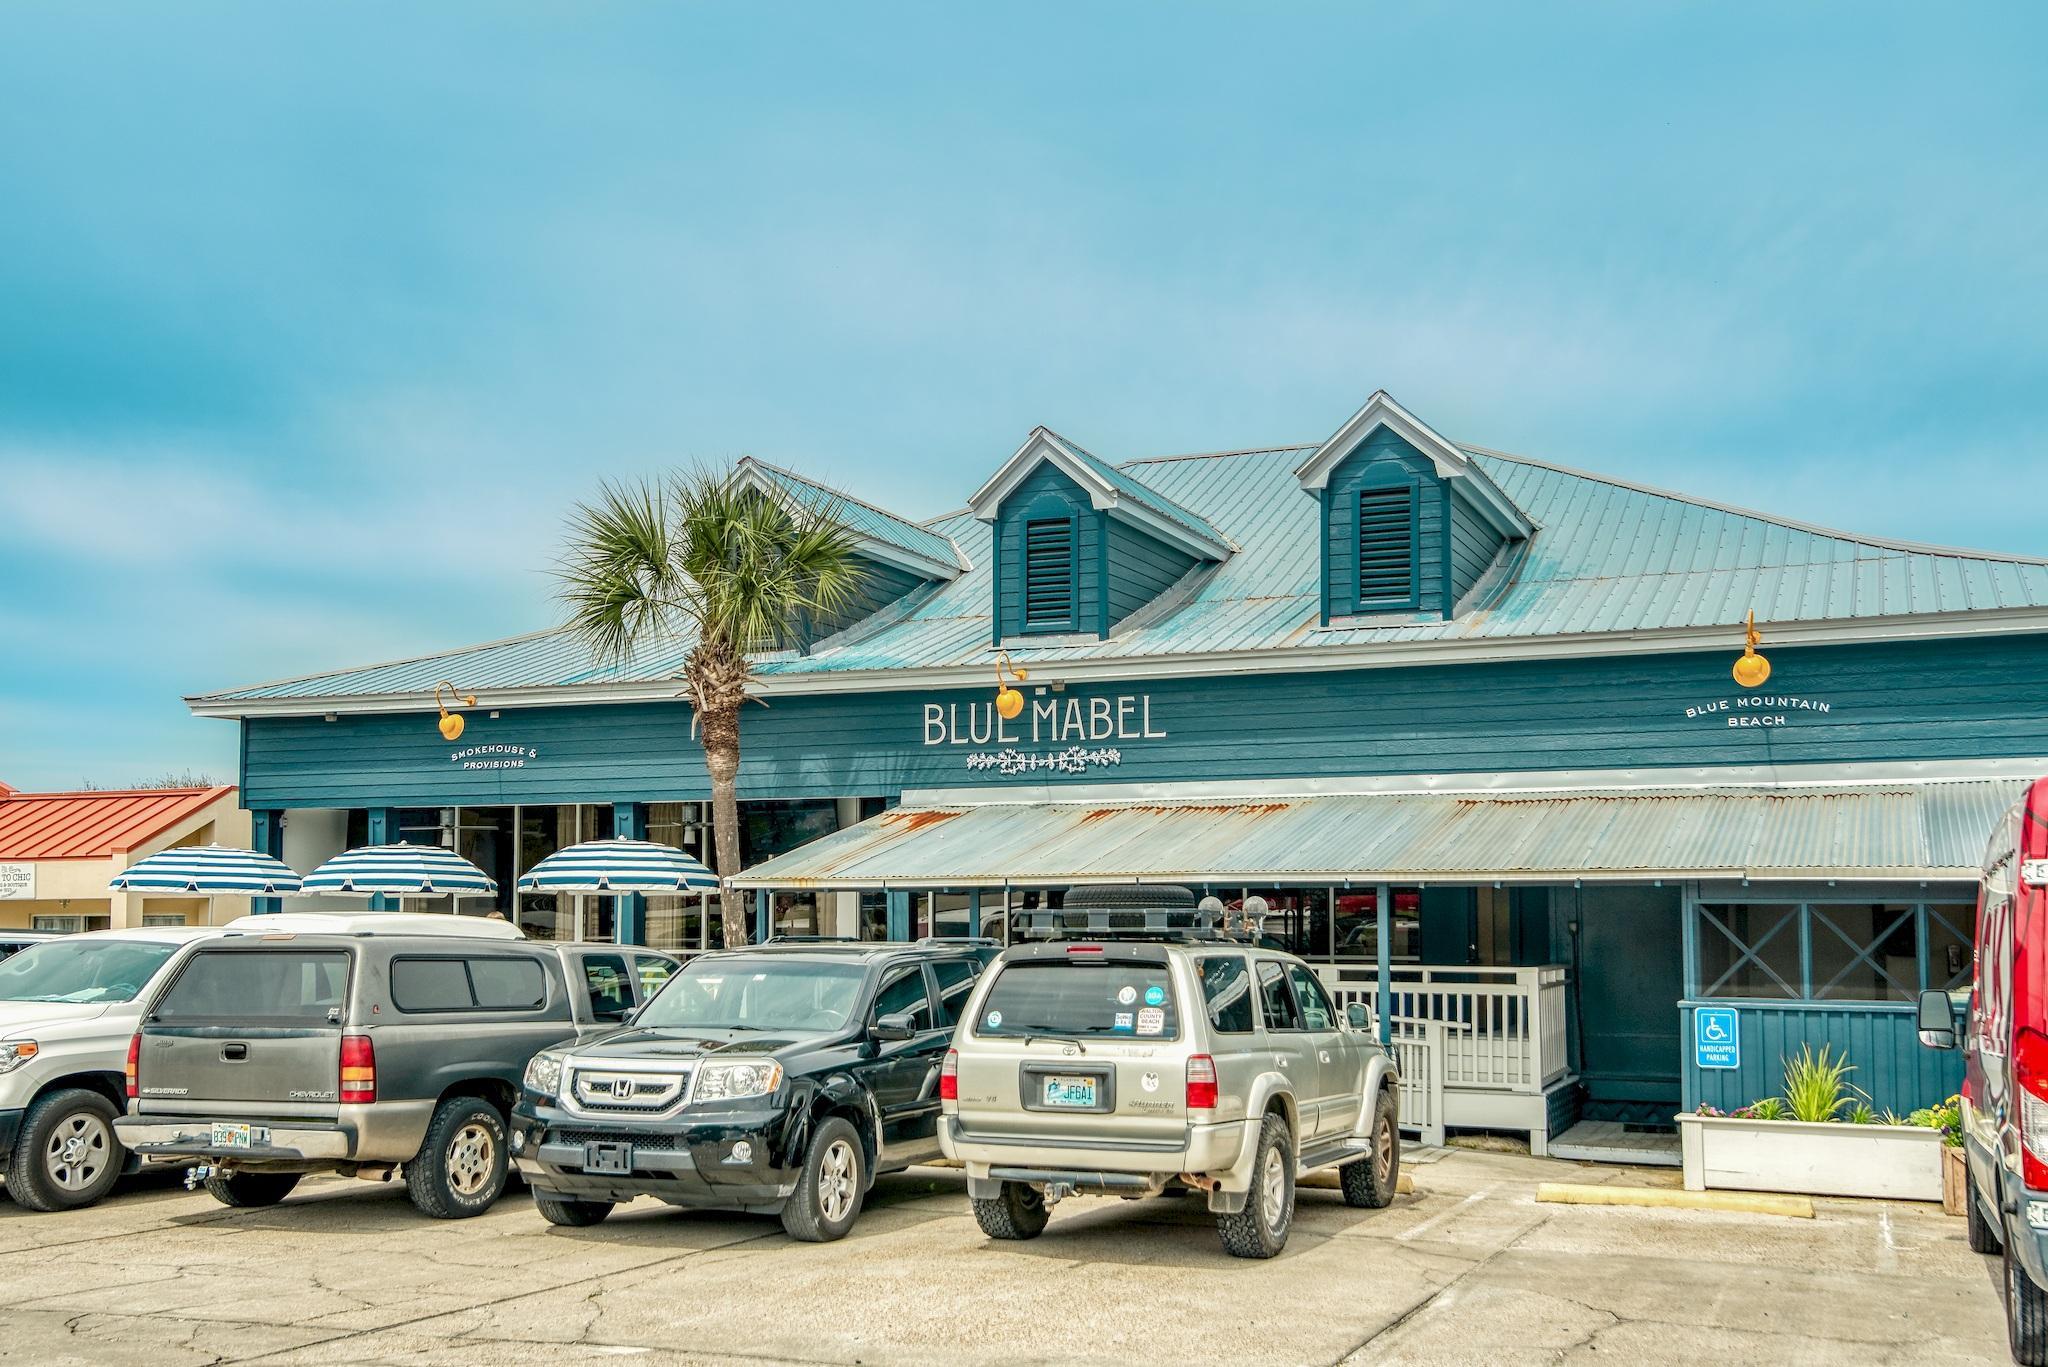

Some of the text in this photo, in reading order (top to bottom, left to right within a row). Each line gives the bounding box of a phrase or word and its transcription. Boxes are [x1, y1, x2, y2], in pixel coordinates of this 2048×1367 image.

[1685, 697, 1831, 718] BLUE MOUNTAIN
[1033, 696, 1167, 742] MABEL
[1728, 716, 1786, 727] BEACH
[451, 745, 537, 762] SMOKEHOUSE &
[463, 760, 524, 770] PROVISIONS
[13, 872, 31, 881] CHIC
[1700, 1045, 1735, 1053] HANDICAPPED
[1706, 1054, 1729, 1062] PARKING
[150, 1087, 189, 1095] SILVERADO
[290, 1090, 335, 1098] CHEVROLET
